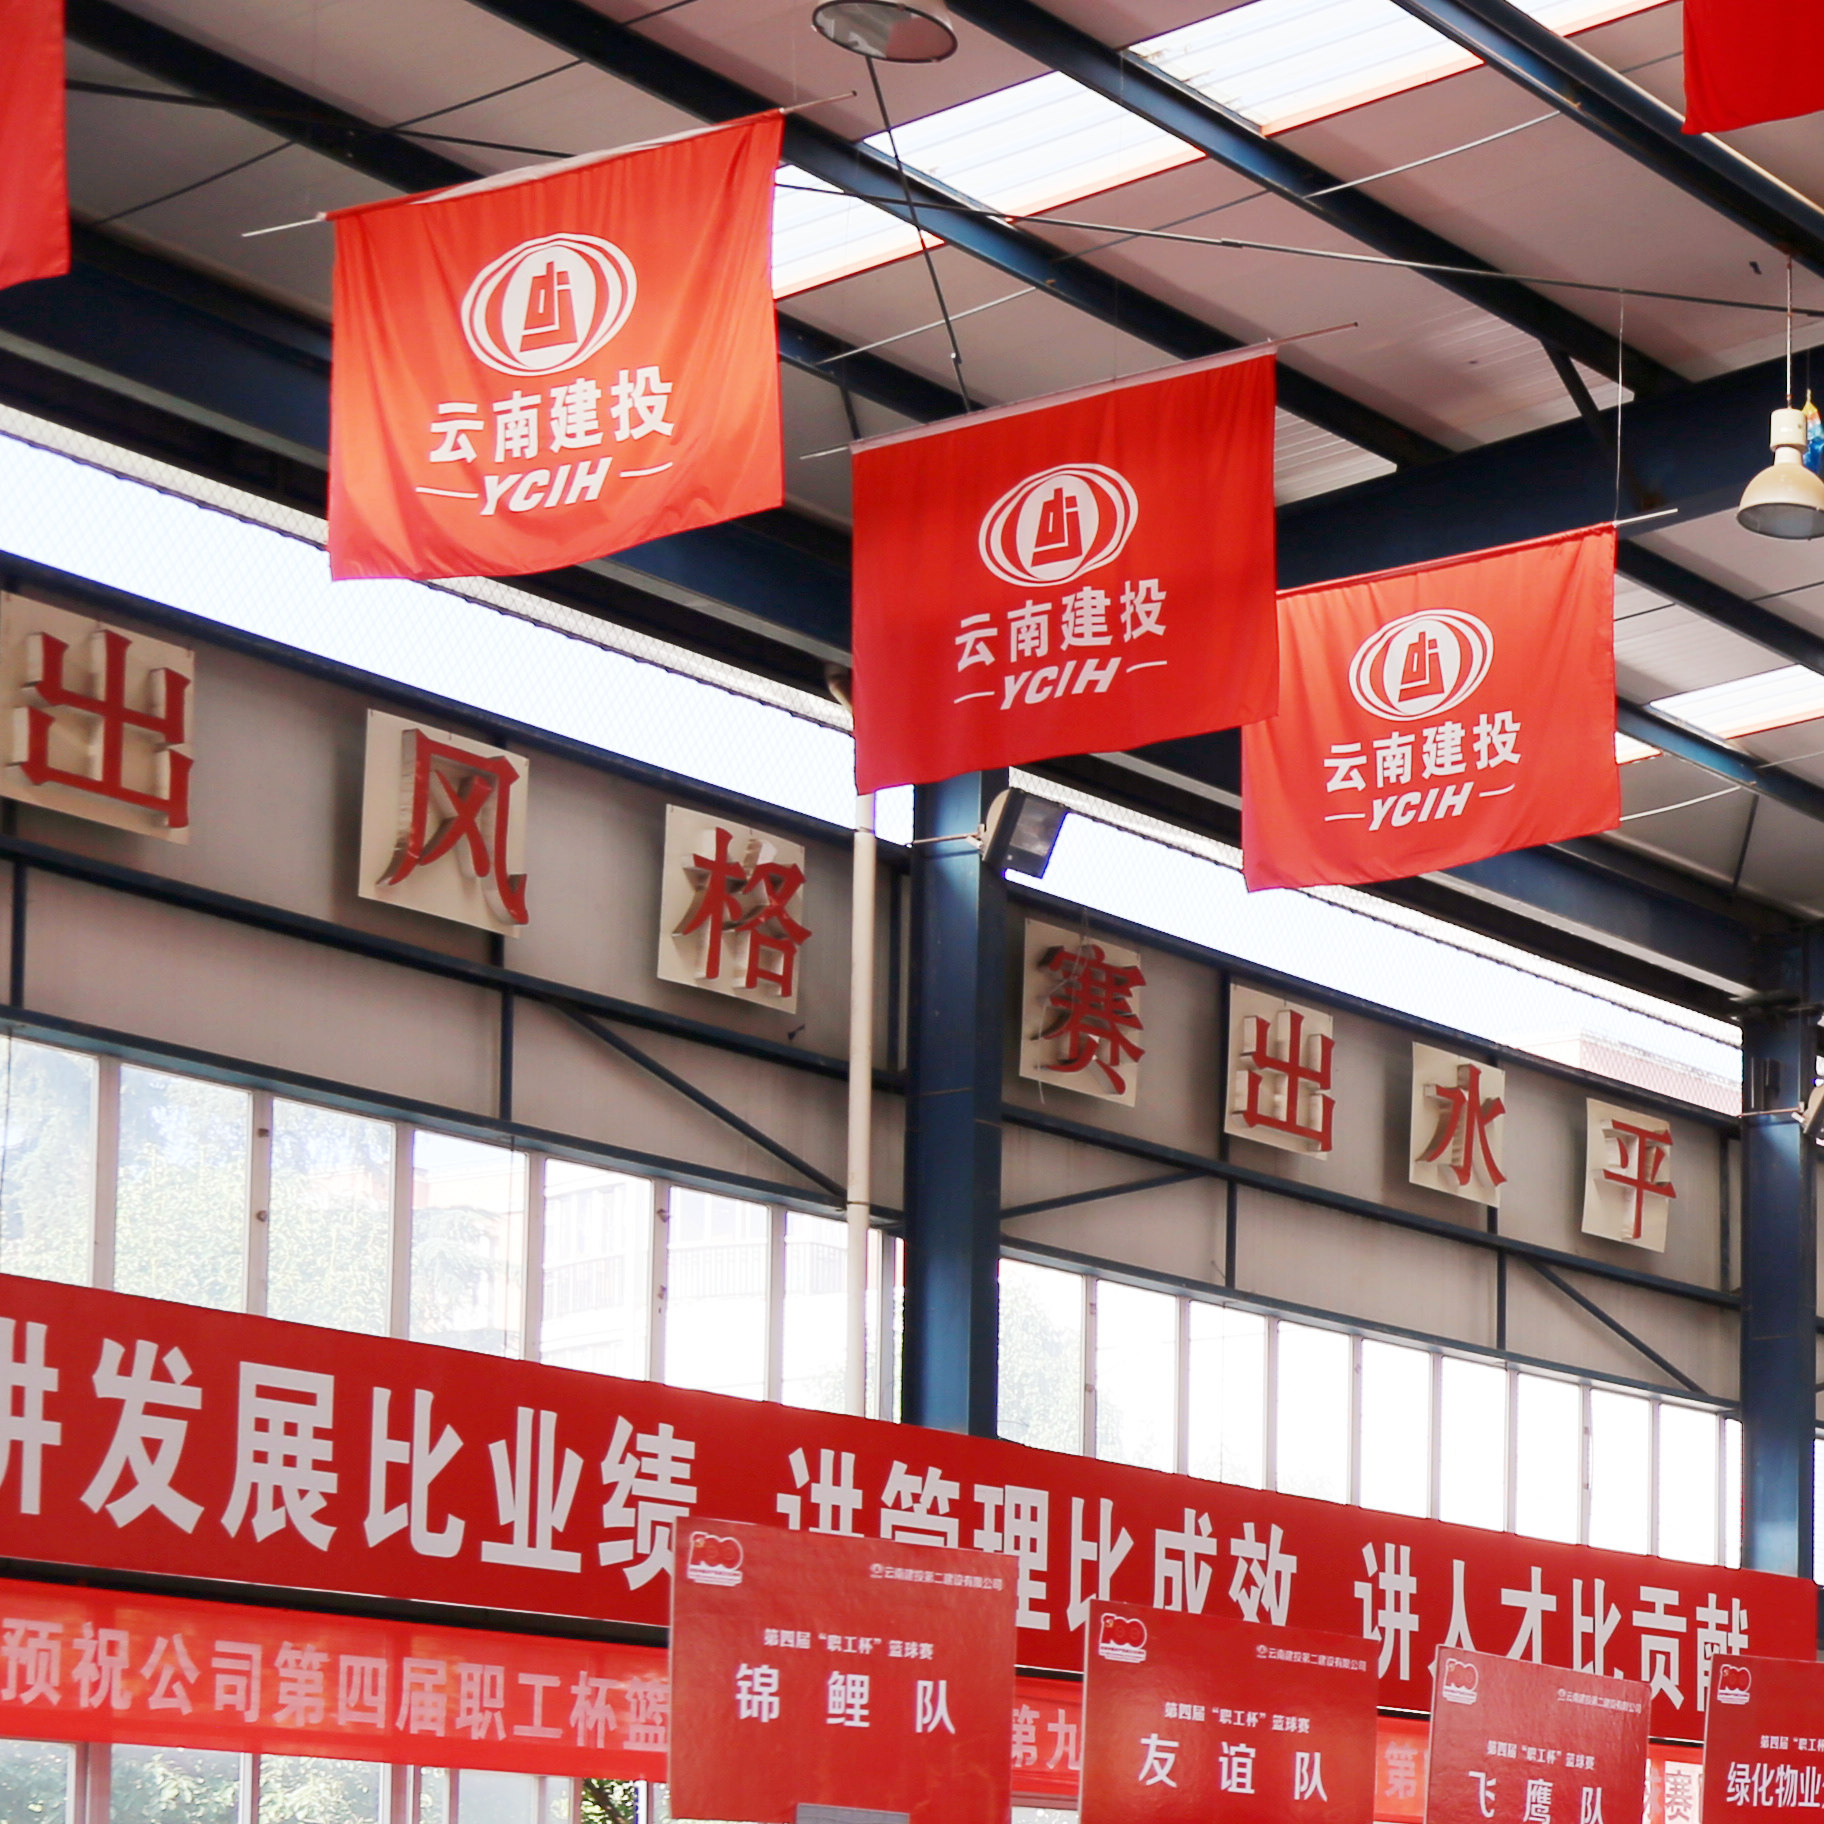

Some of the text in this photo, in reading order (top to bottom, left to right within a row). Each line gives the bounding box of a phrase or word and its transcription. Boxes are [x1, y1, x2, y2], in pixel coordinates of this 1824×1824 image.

[428, 366, 675, 465] 云南建投
[480, 457, 612, 517] YCIH
[954, 578, 1168, 673] 云南建投
[1000, 657, 1123, 711] YCIH
[1323, 711, 1523, 794] 云南建投
[1368, 782, 1473, 832] YCIH
[18, 629, 1677, 1239] 出风格 赛出水平
